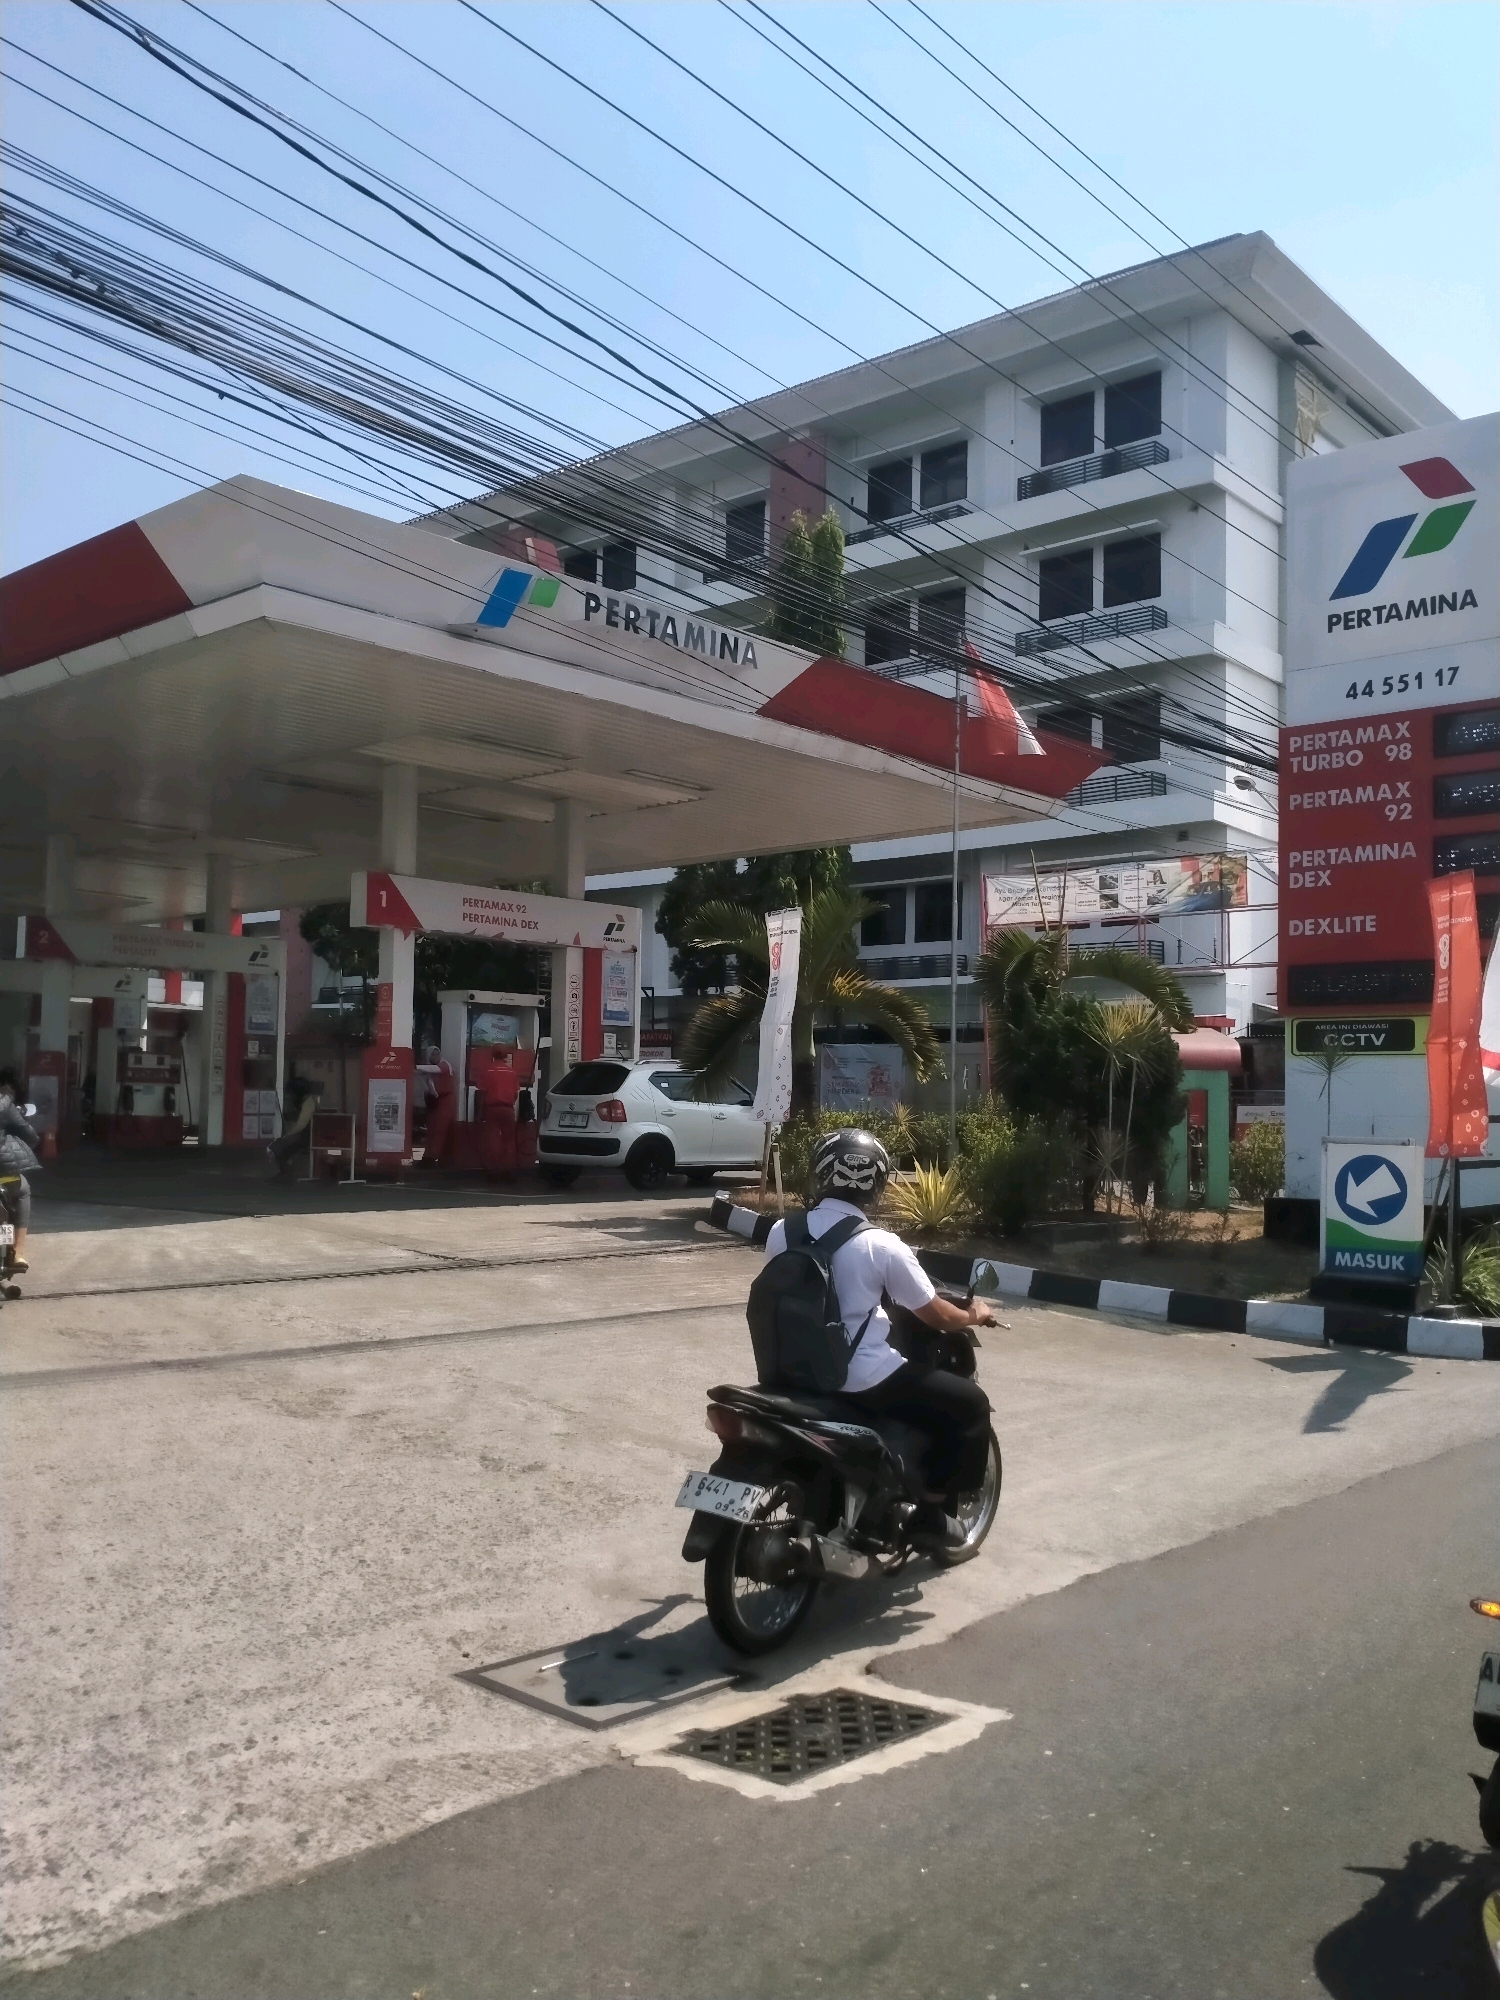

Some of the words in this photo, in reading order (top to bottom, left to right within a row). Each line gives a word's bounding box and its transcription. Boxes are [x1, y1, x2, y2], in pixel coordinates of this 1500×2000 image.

[1327, 589, 1478, 633] PERTAMINA
[584, 592, 758, 669] PERTAMINA
[1346, 679, 1374, 700] 44
[1381, 672, 1423, 695] 551
[1435, 666, 1459, 687] 17
[1289, 721, 1411, 752] PERTAMAX
[1290, 750, 1364, 773] TURBO
[1384, 743, 1412, 762] 98
[1289, 781, 1411, 810] PERTAMAX
[1384, 803, 1412, 821] 92
[1289, 842, 1417, 868] PERTAMINA
[1289, 870, 1332, 888] DEX
[379, 890, 387, 908] 1
[462, 897, 514, 913] PERTAMAX
[516, 904, 527, 914] 92
[462, 912, 518, 928] PERTAMINA
[520, 919, 539, 930] DEX
[1288, 915, 1377, 936] DEXLITE
[1323, 1033, 1386, 1047] CCTV
[1335, 1251, 1404, 1271] MASUK
[698, 1476, 730, 1496] 6441
